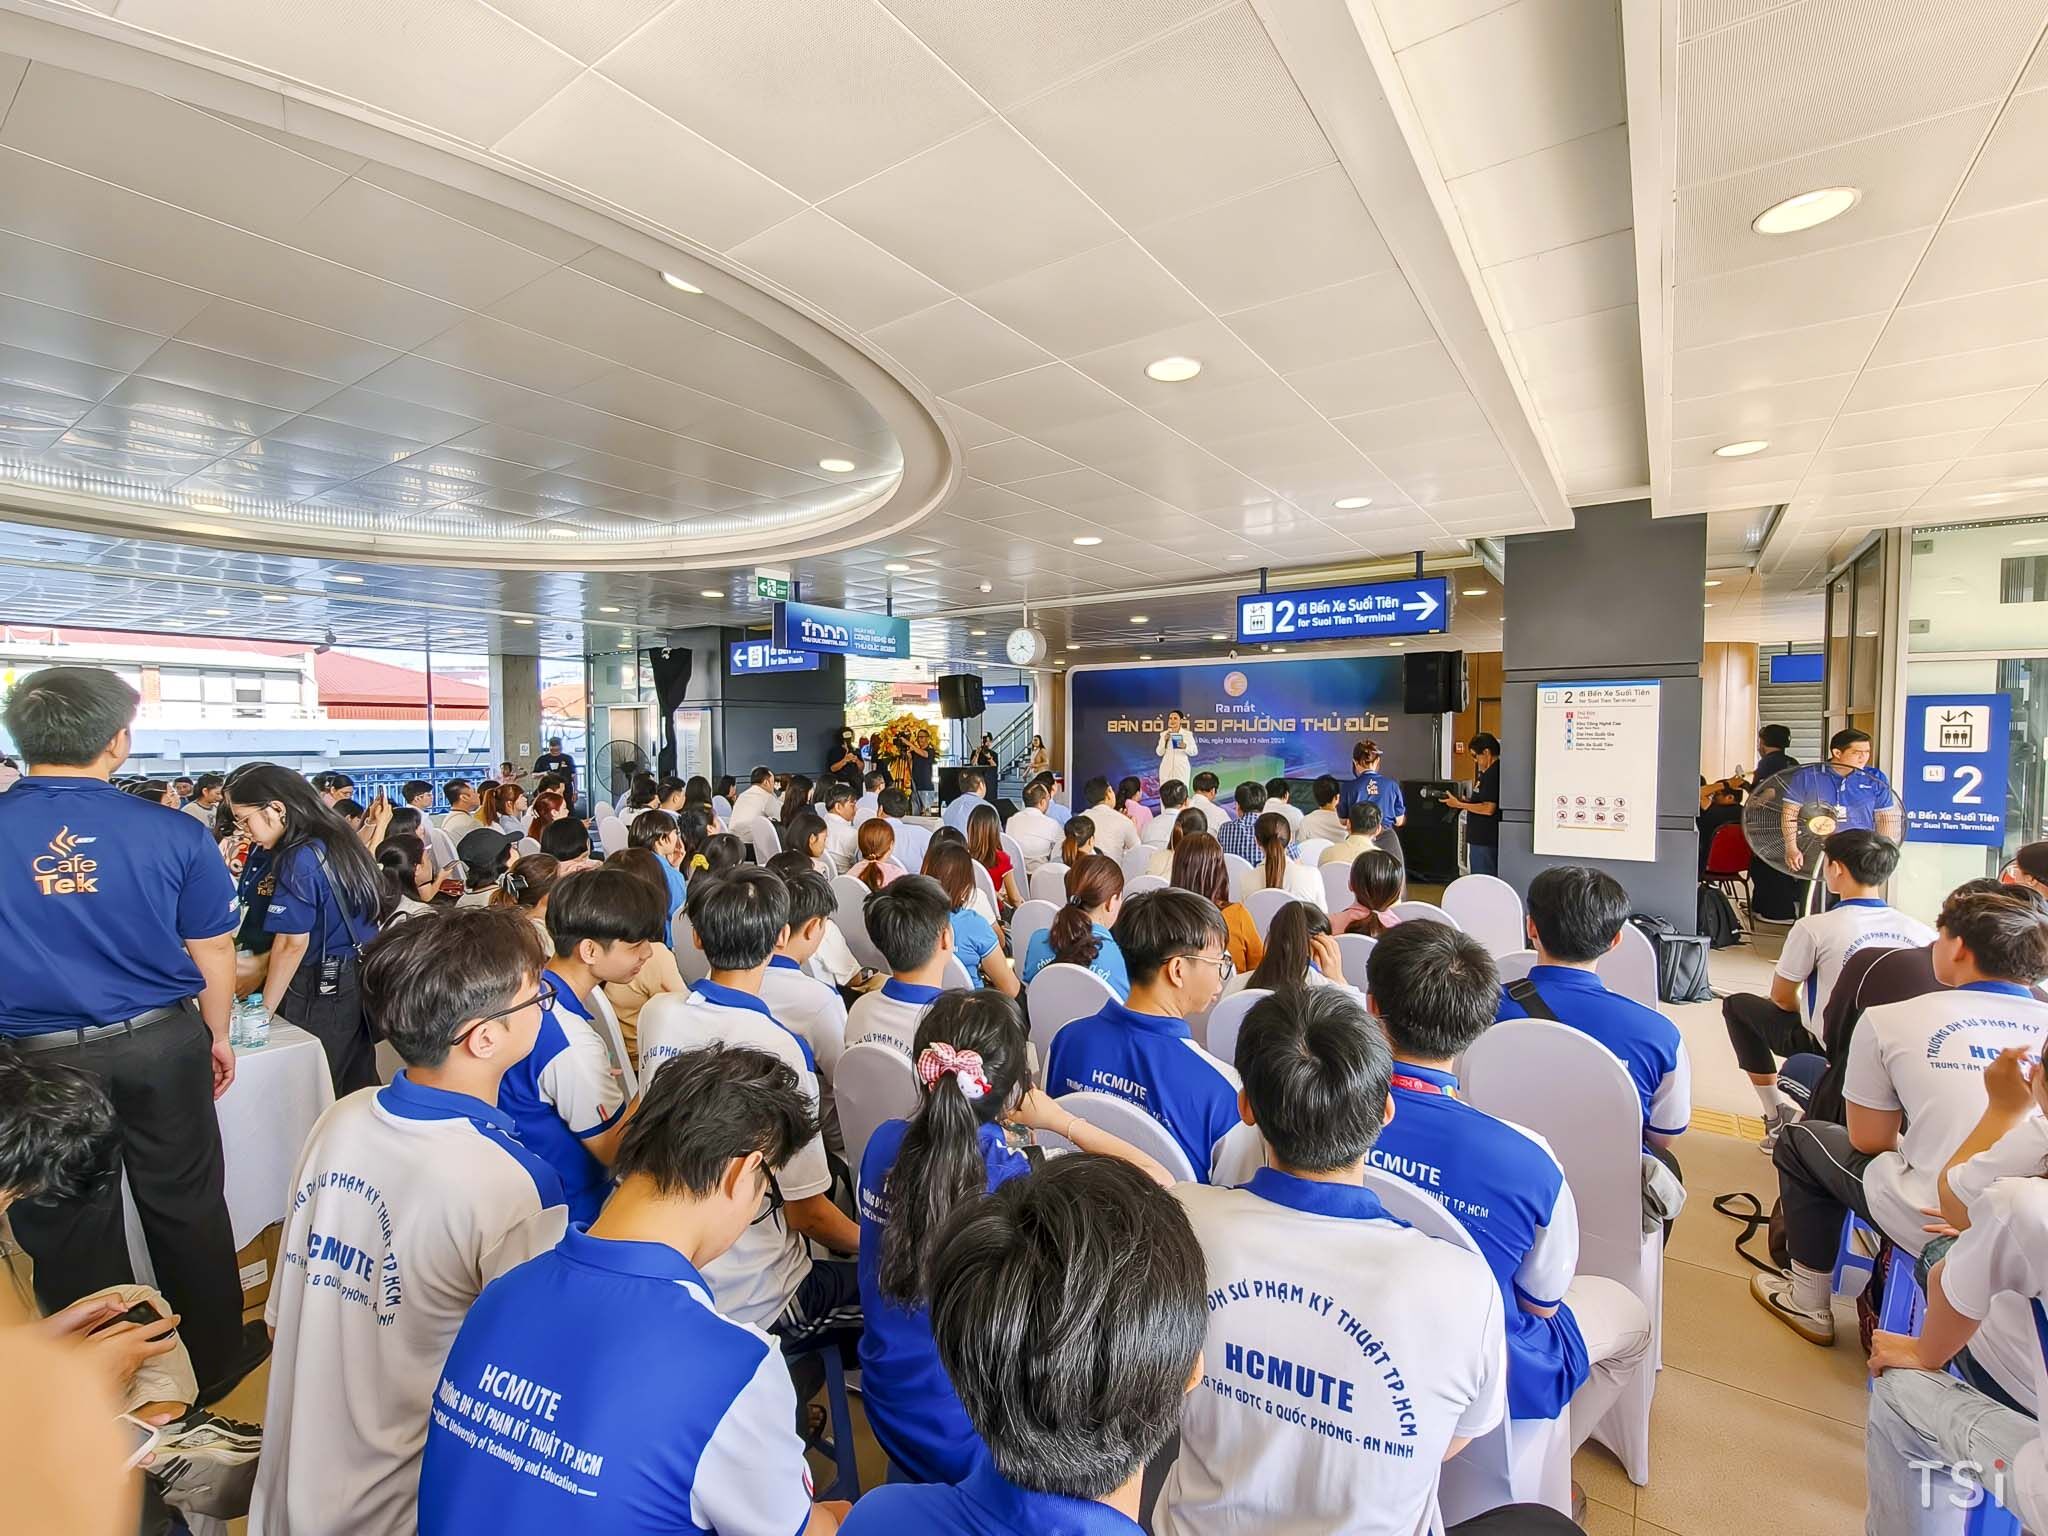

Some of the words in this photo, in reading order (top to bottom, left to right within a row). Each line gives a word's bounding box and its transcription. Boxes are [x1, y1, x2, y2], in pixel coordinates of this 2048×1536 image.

[1298, 603, 1307, 615] đi
[1309, 600, 1331, 615] Bến
[1332, 600, 1347, 613] Xe
[1348, 595, 1373, 611] Suối
[1375, 596, 1399, 609] Tiên
[1275, 600, 1295, 633] 2
[1298, 618, 1310, 628] for
[1312, 616, 1332, 627] Suoi
[1334, 615, 1352, 625] Tien
[1354, 611, 1395, 624] Terminal
[764, 645, 769, 667] 1
[1215, 704, 1231, 713] Ra
[1233, 701, 1256, 713] mắt
[1564, 691, 1573, 704] 2
[1107, 714, 1139, 732] BẢN
[1194, 719, 1218, 732] 3D
[1221, 711, 1296, 732] PHƯỜNG
[1300, 711, 1341, 732] THỦ
[1344, 711, 1389, 732] ĐỨC
[1952, 765, 1983, 804] 2
[1918, 810, 1937, 821] Bến
[1939, 812, 1951, 821] Xe
[1954, 811, 1976, 822] Suối
[1978, 813, 2000, 822] Tiên
[1942, 822, 1958, 830] Tien
[1960, 823, 1995, 831] Terminal
[33, 853, 97, 874] Cafe
[34, 873, 99, 895] Tek
[1927, 1028, 1950, 1059] TRƯỜNG
[1930, 1062, 1959, 1070] TRUNG
[1962, 1062, 1981, 1071] TÂM
[1092, 1069, 1148, 1101] HCMUTE
[331, 1172, 365, 1194] PHẠM
[1453, 1198, 1489, 1218] TP.HCM
[1228, 1278, 1250, 1301] SƯ
[1253, 1280, 1304, 1304] PHẠM
[1338, 1309, 1390, 1366] THUẬT
[1383, 1367, 1418, 1437] TP.HCM
[1225, 1342, 1354, 1413] HCMUTE
[478, 1363, 562, 1422] HCMUTE
[1212, 1378, 1233, 1399] TÂM
[1235, 1389, 1262, 1410] GDTC
[1265, 1400, 1273, 1414] &
[1276, 1403, 1307, 1427] QUỐC
[1310, 1416, 1353, 1444] PHÒNG
[1363, 1436, 1381, 1453] AN
[1384, 1441, 1414, 1459] NINH
[471, 1401, 490, 1423] SƯ
[484, 1407, 514, 1436] PHẠM
[528, 1426, 561, 1460] THUẬT
[560, 1441, 604, 1477] TP.HCM
[449, 1418, 478, 1449] University
[477, 1436, 488, 1450] of
[486, 1439, 526, 1472] Technology
[525, 1460, 540, 1477] and
[540, 1465, 578, 1495] Education
